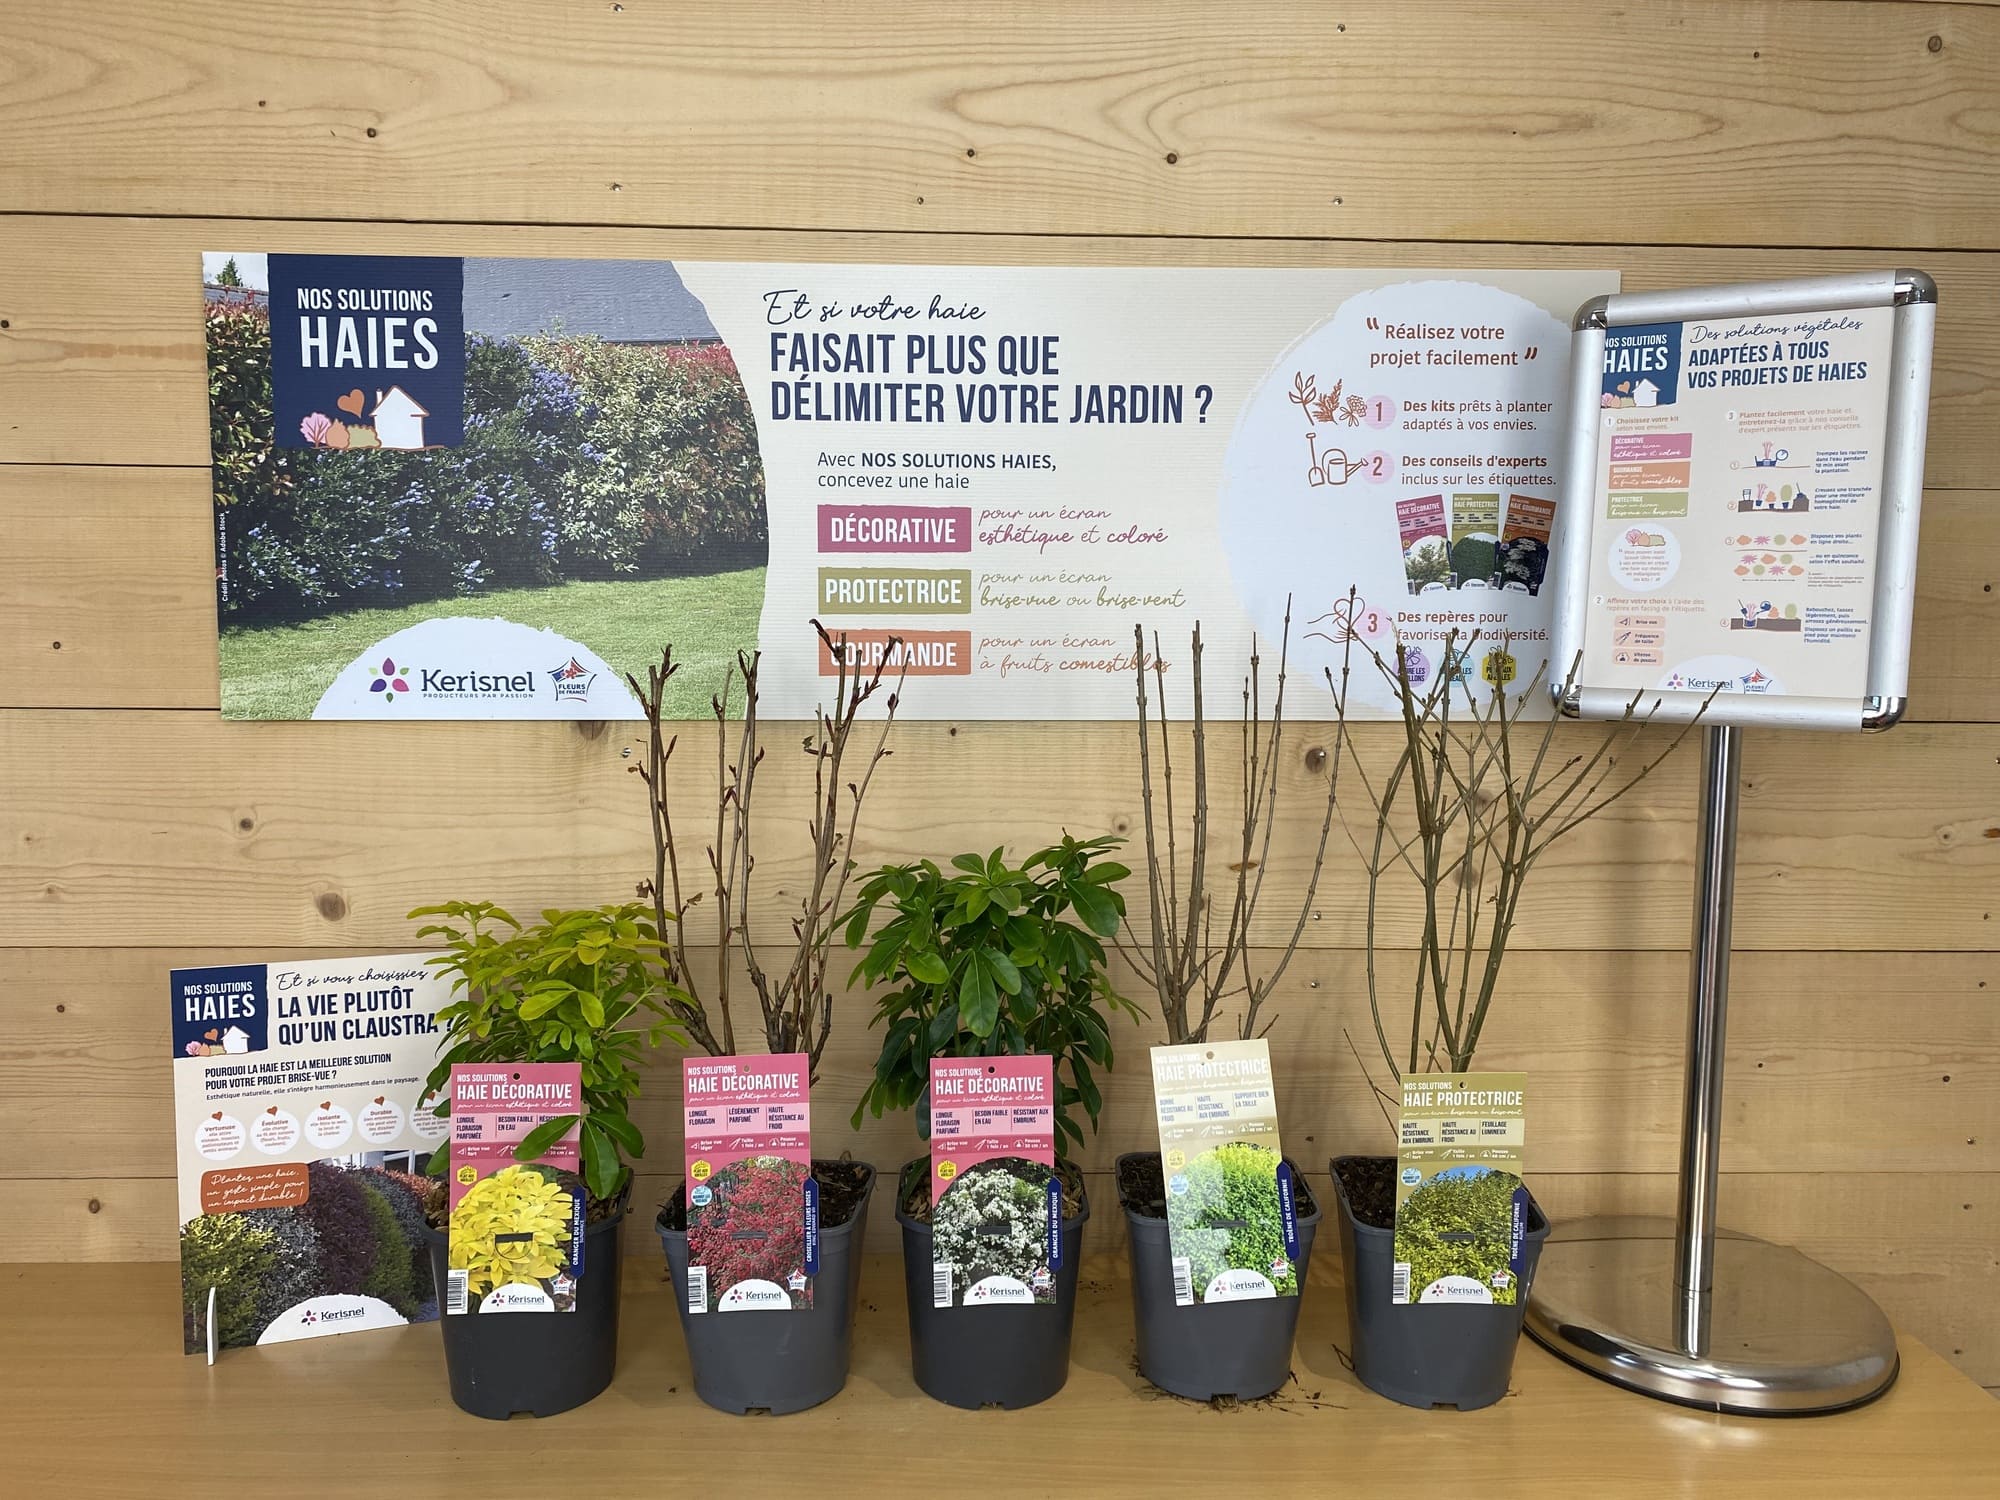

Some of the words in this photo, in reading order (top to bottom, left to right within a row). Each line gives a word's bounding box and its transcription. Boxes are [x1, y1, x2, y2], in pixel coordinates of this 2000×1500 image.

[298, 288, 332, 309] NOS
[338, 289, 432, 311] SOLUTIONS
[763, 289, 812, 325] Et
[820, 299, 843, 322] si
[850, 295, 921, 320] votre
[928, 294, 986, 320] haie
[1385, 323, 1455, 340] Réalisez
[1461, 327, 1504, 340] votre
[1690, 325, 1720, 343] Des
[1725, 325, 1790, 339] solutions
[1793, 317, 1863, 339] végétales
[300, 316, 438, 369] HAIES
[1621, 334, 1668, 347] SOLUTIONS
[770, 332, 895, 374] FAISAIT
[907, 335, 986, 374] PLUS
[998, 335, 1060, 377] QUE
[1370, 350, 1421, 368] projet
[1427, 350, 1518, 365] facilement
[1603, 347, 1668, 374] HAIES
[1688, 344, 1769, 366] ADAPTÉES
[1772, 341, 1783, 361] À
[1788, 341, 1829, 359] TOUS
[1687, 371, 1717, 389] VOS
[1721, 366, 1788, 387] PROJETS
[1793, 364, 1813, 383] DE
[1818, 362, 1867, 381] HAIES
[771, 374, 944, 422] DÉLIMITER
[956, 384, 1059, 424] VOTRE
[1069, 384, 1183, 424] JARDIN
[1195, 384, 1213, 424] ?
[1404, 401, 1427, 411] Des
[1431, 400, 1455, 411] kits
[1459, 401, 1491, 414] prêts
[1496, 401, 1503, 412] à
[1507, 401, 1552, 414] planter
[1376, 402, 1382, 421] 1
[1403, 419, 1452, 432] adaptés
[1457, 419, 1464, 430] à
[1469, 421, 1489, 430] vos
[1493, 420, 1537, 430] envies.
[818, 452, 856, 467] Avec
[862, 453, 896, 468] NOS
[902, 454, 996, 469] SOLUTIONS
[1002, 454, 1057, 472] HAIES,
[1373, 457, 1383, 476] 2
[1402, 456, 1425, 466] Des
[1430, 455, 1482, 467] conseils
[1487, 455, 1547, 469] d'experts
[818, 475, 892, 489] concevez
[899, 476, 929, 489] une
[935, 474, 969, 489] haie
[1402, 473, 1438, 485] inclus
[1443, 476, 1463, 485] sur
[1467, 474, 1484, 485] les
[1489, 473, 1556, 487] étiquettes.
[979, 509, 1022, 526] pour
[1029, 509, 1054, 519] un
[1060, 506, 1112, 519] écran
[831, 514, 956, 543] DÉCORATIVE
[979, 526, 1074, 554] esthétique
[1081, 526, 1100, 543] et
[1107, 526, 1168, 543] coloré
[979, 573, 1023, 590] pour
[1030, 574, 1055, 583] un
[1060, 570, 1112, 583] écran
[825, 579, 962, 604] PROTECTRICE
[981, 586, 1061, 608] brise-vue
[1068, 596, 1089, 607] ou
[1097, 587, 1186, 608] brise-vent
[1368, 614, 1378, 632] 3
[1398, 612, 1420, 622] Des
[1426, 611, 1475, 625] repères
[1479, 613, 1508, 625] pour
[979, 638, 1024, 654] pour
[1031, 638, 1055, 648] un
[1062, 634, 1116, 648] écran
[1398, 629, 1452, 641] favorise
[1457, 629, 1467, 640] la
[981, 656, 994, 670] à
[1000, 654, 1052, 678] fruits
[421, 669, 535, 692] Kerisnel
[184, 984, 201, 995] NOS
[204, 982, 252, 994] SOLUTIONS
[276, 972, 302, 990] Et
[307, 974, 320, 987] si
[324, 976, 353, 985] vous
[358, 969, 429, 982] choisissiez
[185, 993, 256, 1022] HAIES
[277, 996, 304, 1018] LA
[308, 995, 338, 1015] VIE
[342, 985, 414, 1013] PLUTÔT
[343, 1013, 438, 1040] CLAUSTRA
[205, 1065, 246, 1077] POURQUOI
[248, 1064, 258, 1074] LA
[260, 1062, 279, 1074] HAIE
[281, 1061, 295, 1071] EST
[298, 1060, 307, 1070] LA
[309, 1057, 352, 1069] MEILLEURE
[355, 1054, 391, 1066] SOLUTION
[688, 1067, 700, 1075] NOS
[702, 1065, 736, 1075] SOLUTIONS
[949, 1068, 982, 1076] SOLUTIONS
[1156, 1063, 1184, 1081] HAIE
[1188, 1058, 1268, 1079] PROTECTRICE
[205, 1080, 227, 1090] POUR
[229, 1078, 255, 1088] VOTRE
[258, 1077, 286, 1087] PROJET
[289, 1071, 331, 1084] BRISE-VUE
[332, 1071, 337, 1079] ?
[457, 1074, 471, 1082] NOS
[472, 1074, 507, 1082] SOLUTIONS
[689, 1078, 718, 1093] HAIE
[722, 1073, 799, 1091] DÉCORATIVE
[936, 1079, 964, 1095] HAIE
[968, 1074, 1044, 1093] DÉCORATIVE
[1418, 1082, 1452, 1090] SOLUTIONS
[457, 1085, 488, 1100] HAIE
[492, 1080, 572, 1099] DÉCORATIVE
[1404, 1092, 1432, 1107] HAIE
[1437, 1091, 1523, 1106] PROTECTRICE
[573, 1227, 579, 1236] DU
[508, 1295, 544, 1304] Kerisnel
[746, 1291, 781, 1300] Kerisnel
[990, 1287, 1025, 1296] Kerisnel
[1448, 1286, 1483, 1295] Kerisnel
[321, 1307, 365, 1320] Kerisnel
